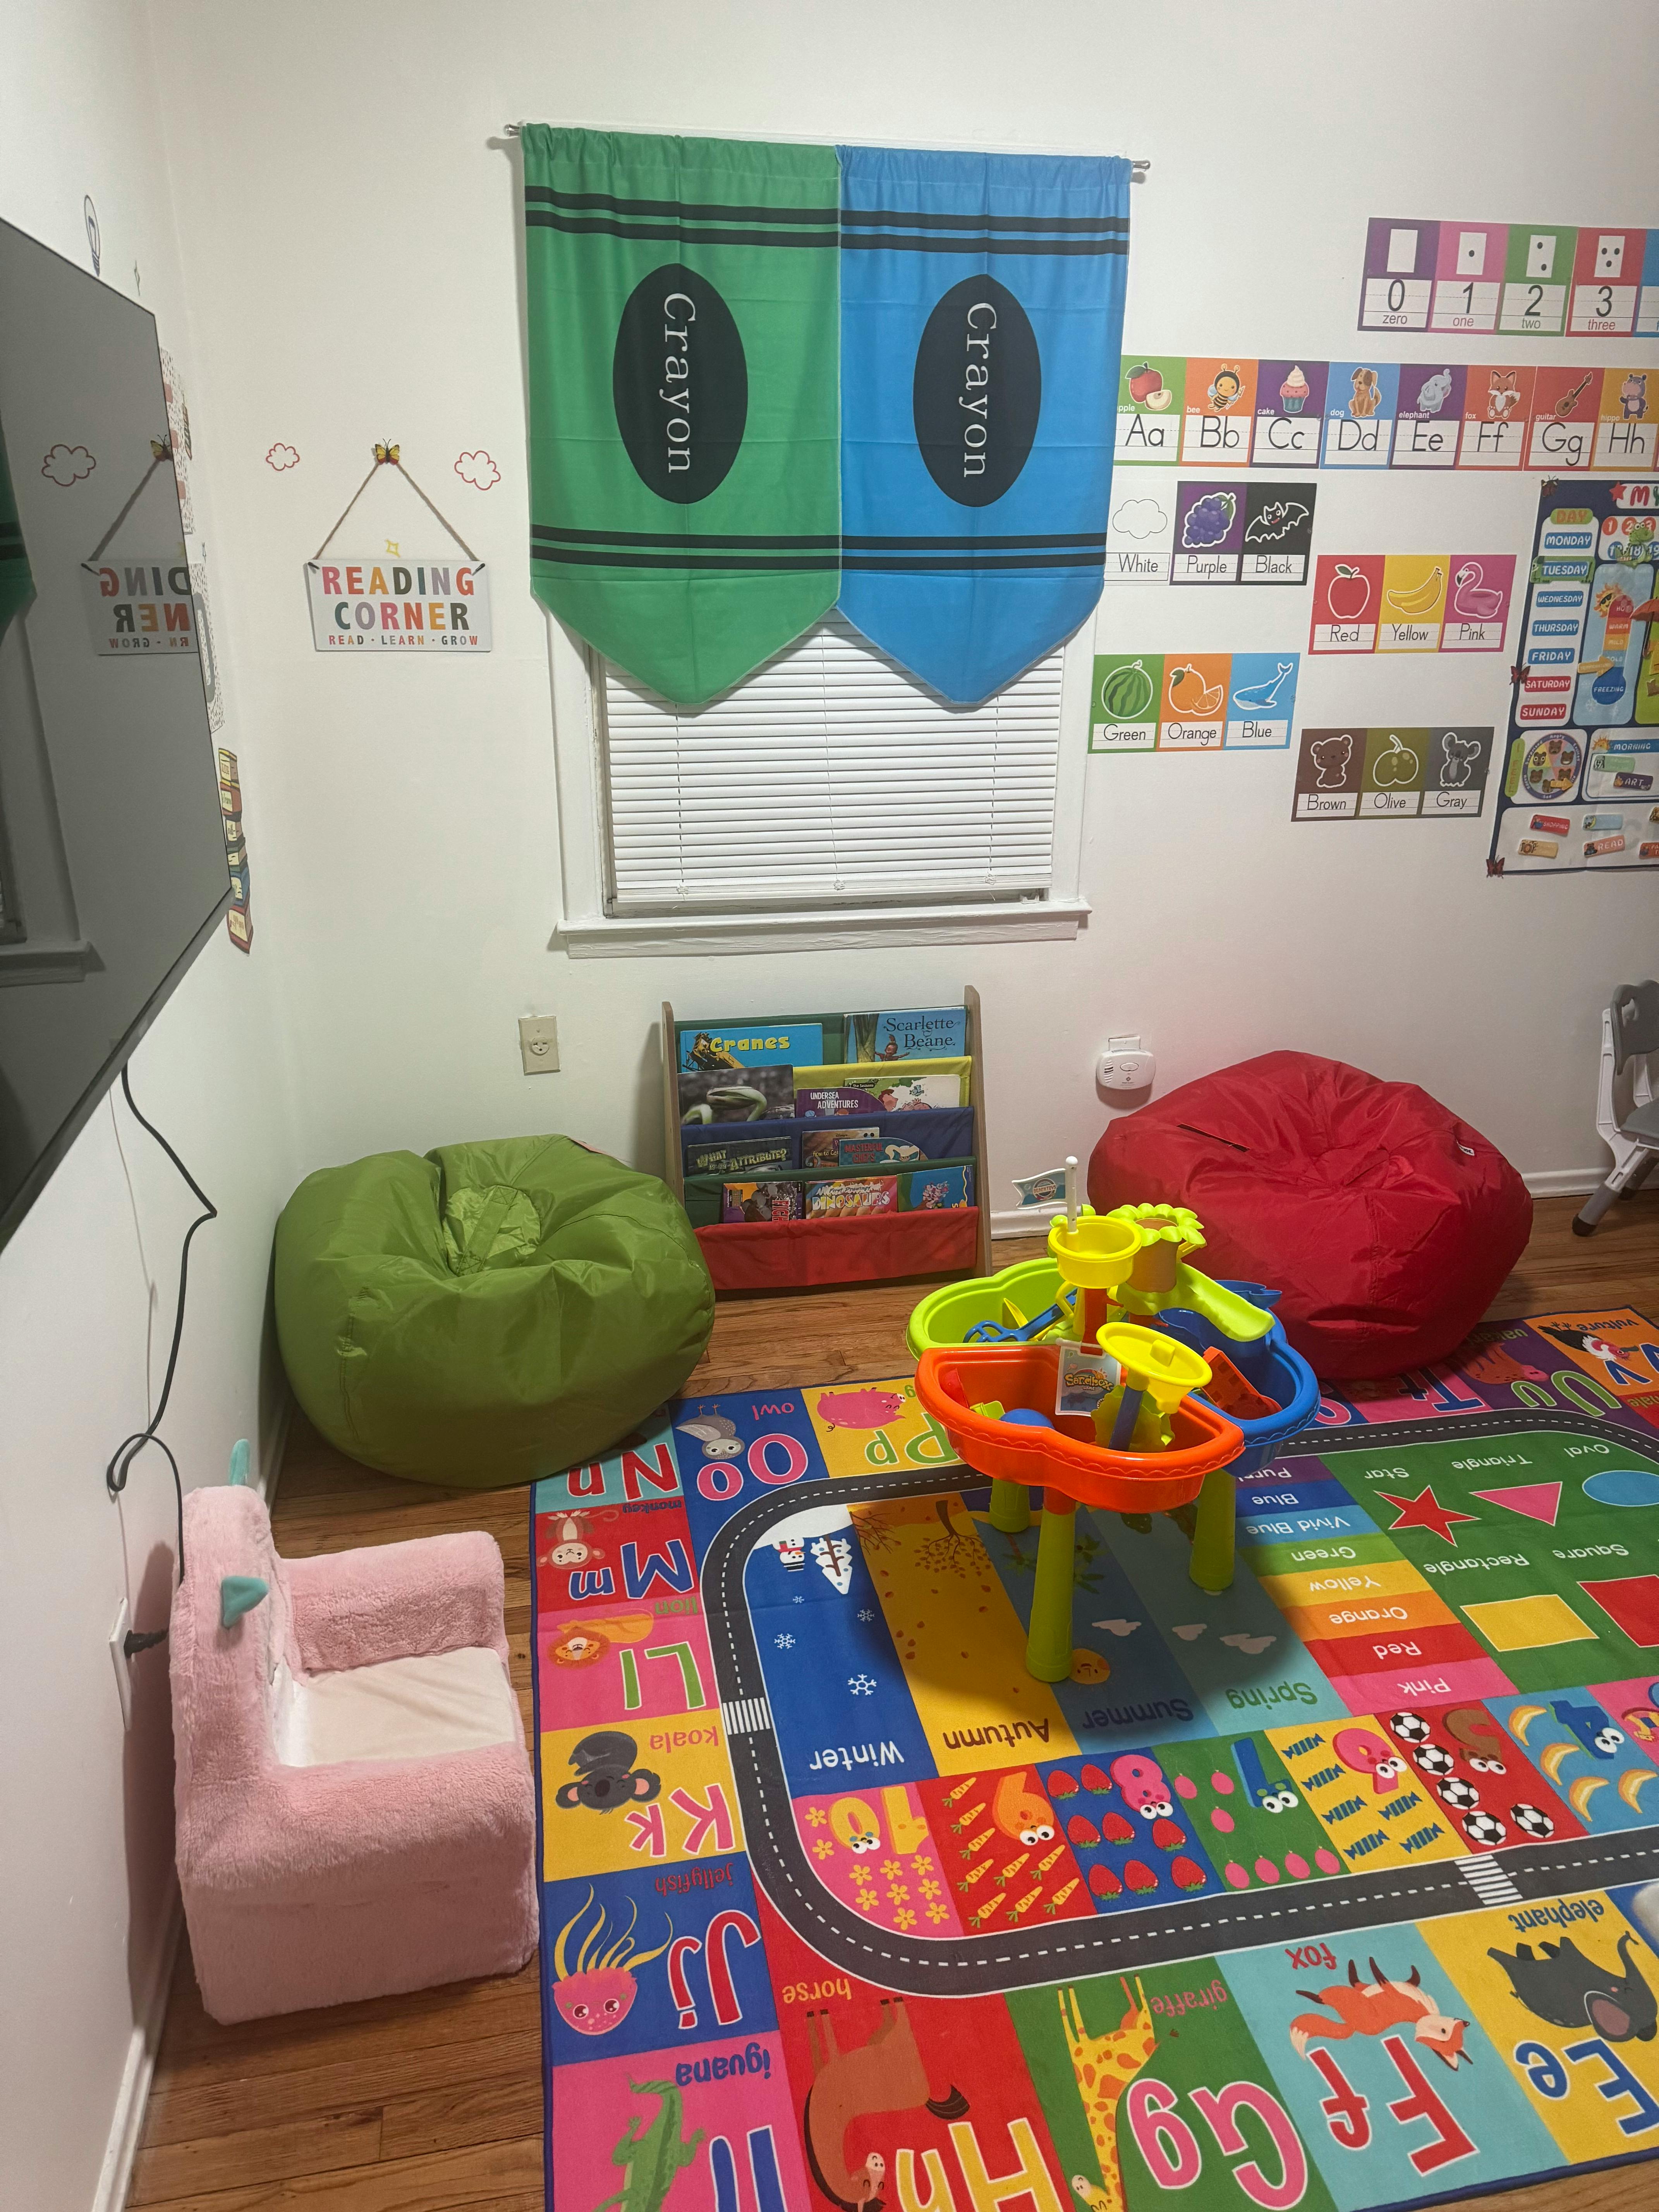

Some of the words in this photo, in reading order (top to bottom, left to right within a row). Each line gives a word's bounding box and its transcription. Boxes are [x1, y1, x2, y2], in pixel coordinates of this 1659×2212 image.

[1388, 279, 1405, 311] 0
[1462, 282, 1474, 314] 1
[1525, 285, 1544, 316] 2
[1596, 285, 1613, 317] 3
[1382, 314, 1408, 325] zero
[1453, 316, 1474, 327] one
[1522, 318, 1541, 329] two
[1588, 319, 1615, 330] three
[658, 292, 696, 474] Crayon
[958, 302, 997, 478] Crayon
[1118, 404, 1135, 413] pple
[1330, 409, 1344, 418] dog
[1399, 410, 1429, 421] elephant
[1601, 414, 1620, 422] hippo
[1125, 414, 1164, 447] Aa
[1200, 415, 1240, 448] Bb
[1268, 417, 1305, 449] Cc
[1338, 419, 1379, 451] Dd
[1412, 421, 1444, 452] Ee
[1477, 421, 1509, 452] Ff
[1542, 422, 1583, 466] Gg
[1609, 423, 1645, 453] Hh
[1556, 510, 1587, 523] DAY
[1546, 536, 1591, 545] MONDAY
[1118, 553, 1158, 573] White
[1187, 555, 1227, 579] Purple
[1255, 555, 1292, 573] Black
[1542, 565, 1587, 575] TUESDAY
[322, 566, 474, 596] READING
[335, 602, 469, 630] CORNER
[1330, 624, 1359, 642] Red
[1391, 624, 1428, 641] Yellow
[1460, 623, 1486, 641] Pink
[1534, 623, 1578, 633] THURSDAY
[329, 635, 364, 645] READ
[381, 635, 424, 645] LEARN
[441, 635, 478, 645] GROW
[1532, 651, 1571, 661] FRIDAY
[1526, 680, 1570, 689] SATURDAY
[1522, 707, 1565, 716] SUNDAY
[1104, 725, 1146, 740] Green
[1168, 723, 1216, 746] Orange
[1242, 721, 1272, 738] Blue
[1625, 778, 1644, 787] ART
[1307, 794, 1346, 811] Brown
[1374, 793, 1406, 809] Olive
[1436, 792, 1467, 809] Gray
[1543, 821, 1568, 830] SHOPPING
[1598, 840, 1623, 850] READ
[884, 1015, 960, 1032] Scarlette
[709, 1037, 790, 1053] Cranes
[811, 1092, 839, 1100] UNDERSEA
[817, 1100, 859, 1109] ADVENTURES
[844, 1143, 883, 1153] MASTERFUL
[697, 1150, 726, 1168] WHAT
[730, 1148, 787, 1171] ATTRIBUTE?
[852, 1153, 875, 1163] CHEFS
[812, 1191, 890, 1210] DINOSAURS
[1577, 1319, 1638, 1331] vulture
[1065, 1374, 1114, 1390] Sandbox
[752, 1403, 794, 1420] owl
[1564, 1444, 1609, 1457] Oval
[1452, 1454, 1532, 1470] Triangle
[1365, 1468, 1409, 1479] Star
[622, 1499, 682, 1513] monkey
[1252, 1494, 1299, 1505] Blue
[1246, 1522, 1294, 1534] Blue
[1297, 1516, 1350, 1532] Vivid
[1291, 1546, 1355, 1561] Green
[1553, 1544, 1629, 1559] Square
[1424, 1554, 1530, 1575] Rectangle
[1310, 1575, 1381, 1591] Yellow
[655, 1595, 697, 1614] lion
[1329, 1607, 1408, 1624] Orange
[1373, 1642, 1422, 1659] Red
[1397, 1677, 1451, 1694] Pink
[1226, 1682, 1317, 1710] Spring
[1082, 1698, 1193, 1729] Summer
[650, 1726, 718, 1753] koala
[943, 1718, 1049, 1750] Autumn
[811, 1741, 904, 1771] Winter
[655, 1862, 733, 1896] jellyfish
[1508, 1899, 1604, 1932] elephant
[1285, 1943, 1337, 1970] fox
[782, 1978, 851, 2003] horse
[1150, 1979, 1227, 2017] giraffe
[676, 2042, 770, 2087] iguana
